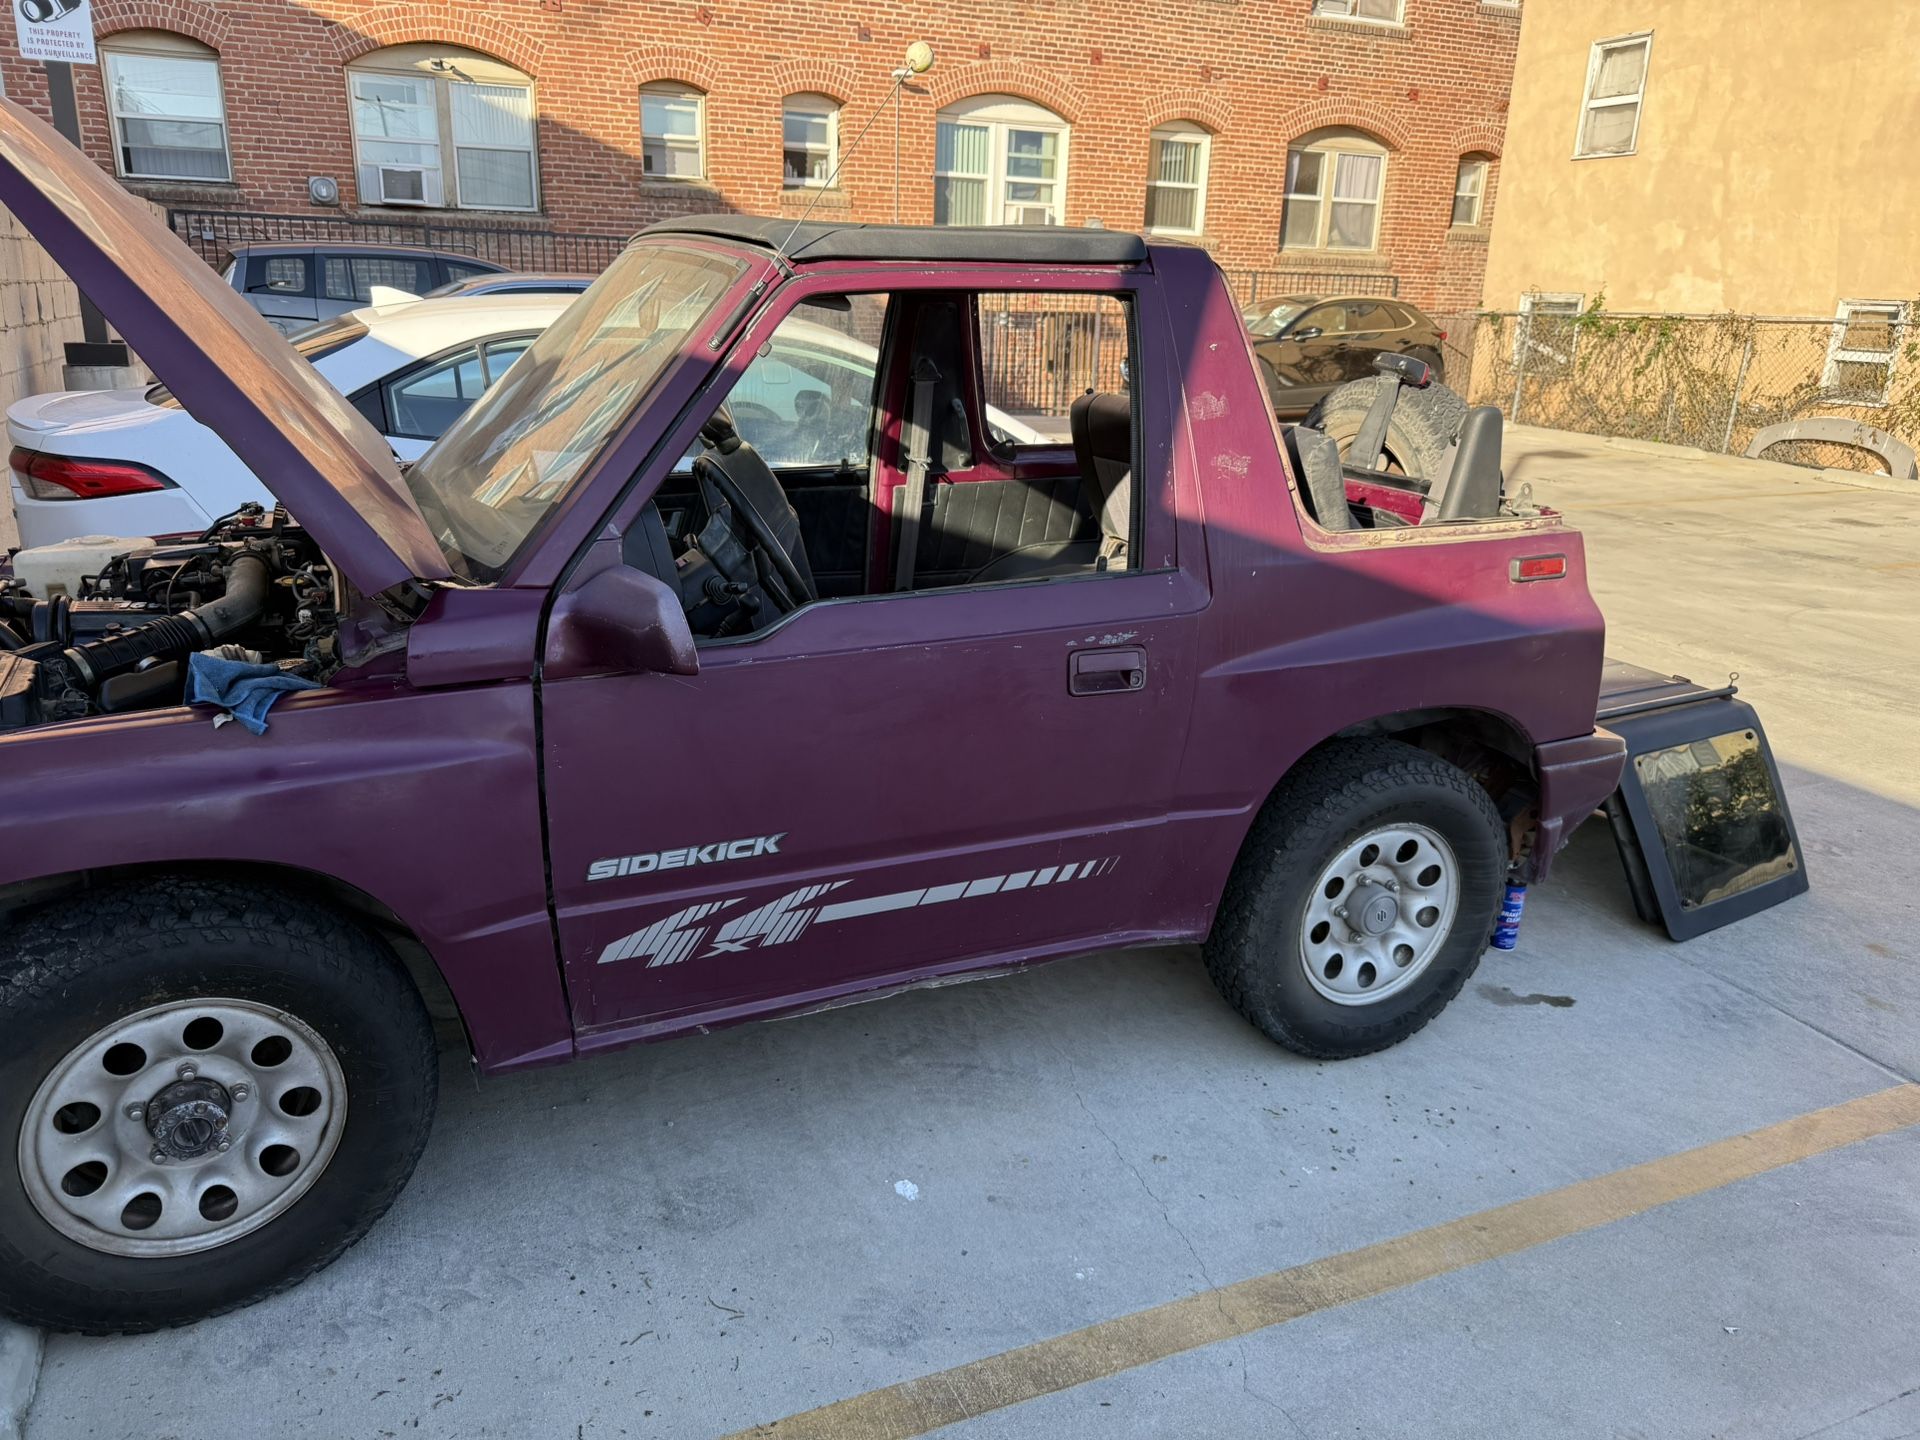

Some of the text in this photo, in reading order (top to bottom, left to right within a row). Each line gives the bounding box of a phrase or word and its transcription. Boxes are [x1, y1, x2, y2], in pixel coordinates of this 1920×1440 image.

[29, 27, 80, 38] THIS PROPERTY
[36, 38, 74, 48] PROTECTED
[76, 41, 85, 49] BY
[22, 47, 93, 60] VIDEO SURVEILLANCE
[587, 832, 788, 881] SIDEKICK
